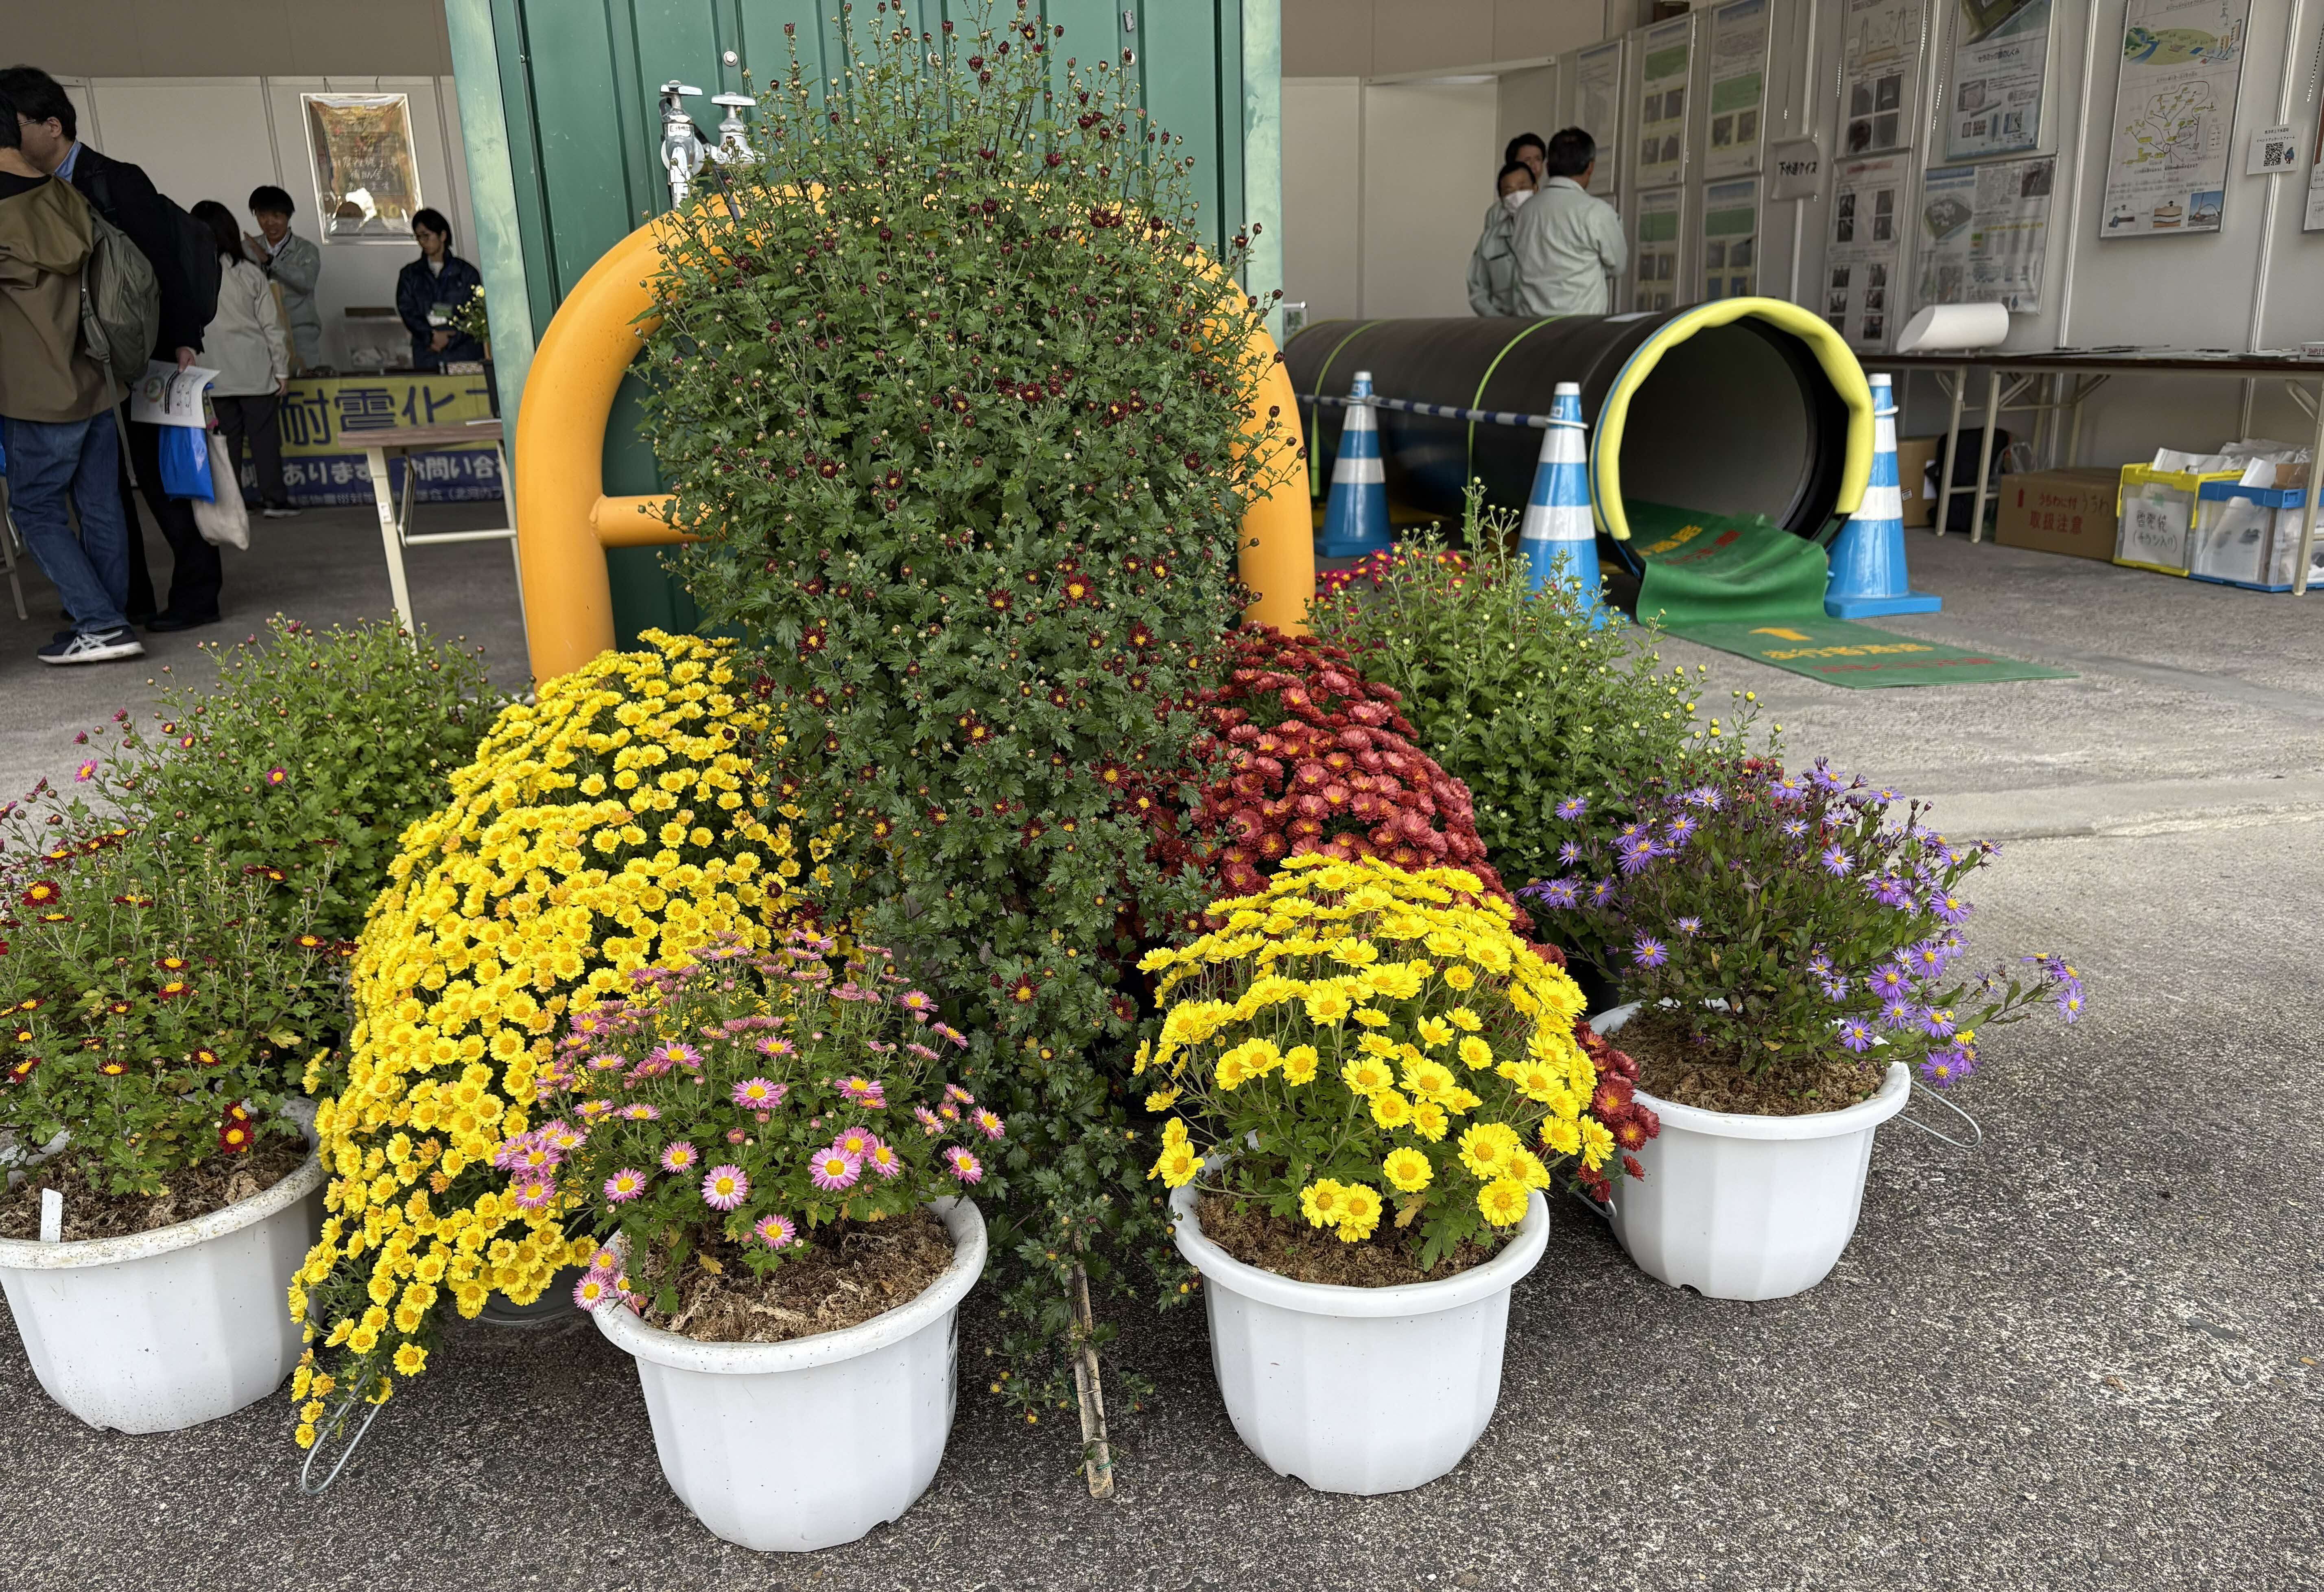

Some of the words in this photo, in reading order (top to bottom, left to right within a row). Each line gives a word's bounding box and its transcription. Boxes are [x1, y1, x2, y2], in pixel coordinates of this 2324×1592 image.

[281, 386, 489, 446] 耐震化
[2029, 510, 2083, 535] 取扱注意
